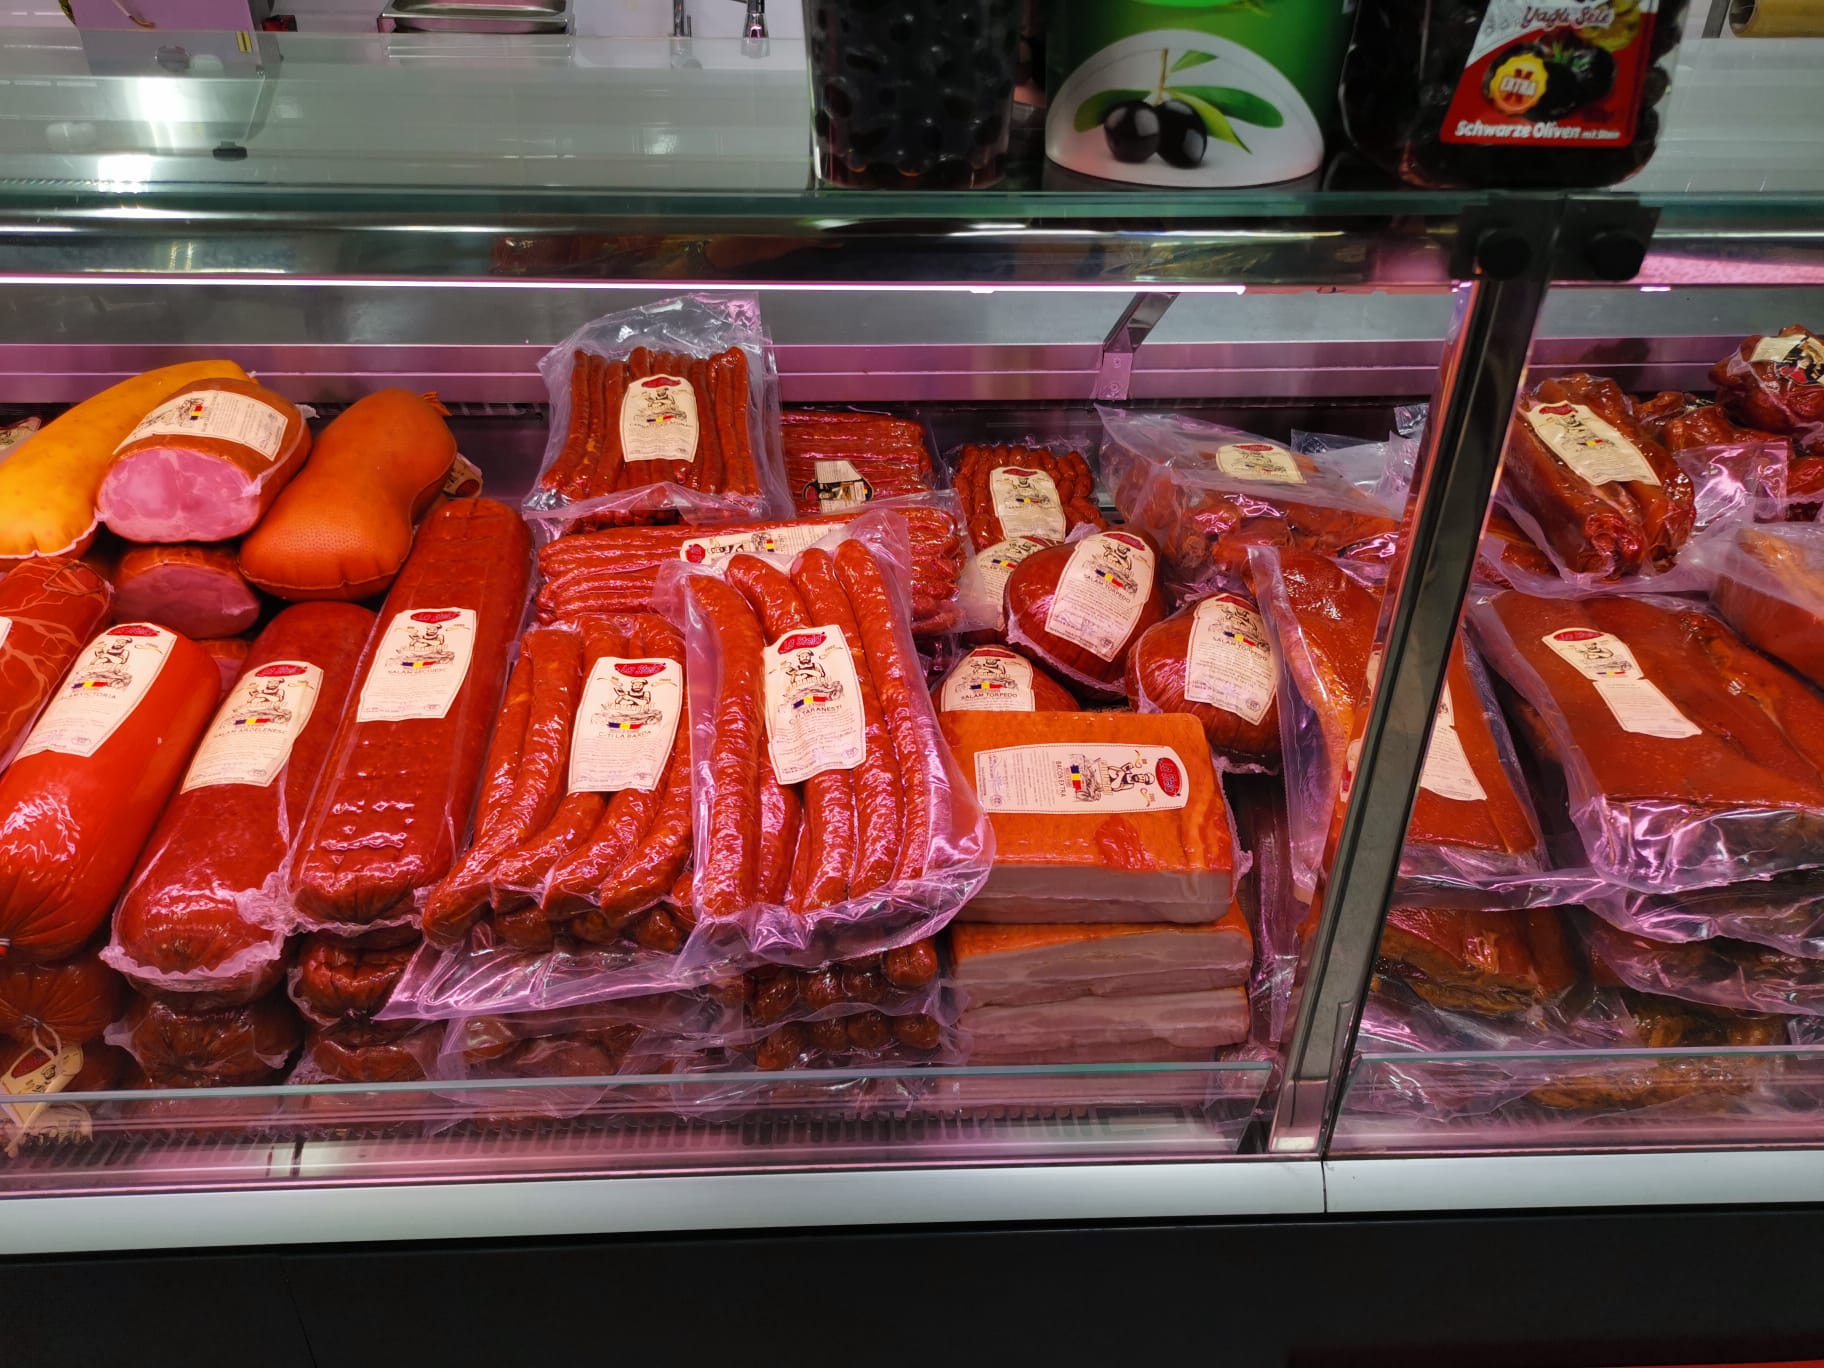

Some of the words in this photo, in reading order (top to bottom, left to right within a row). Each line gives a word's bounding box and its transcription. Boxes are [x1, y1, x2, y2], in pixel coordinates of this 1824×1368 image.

[1501, 77, 1537, 95] EXTRA
[1455, 120, 1532, 137] Schwarze
[1533, 121, 1581, 139] Oliven
